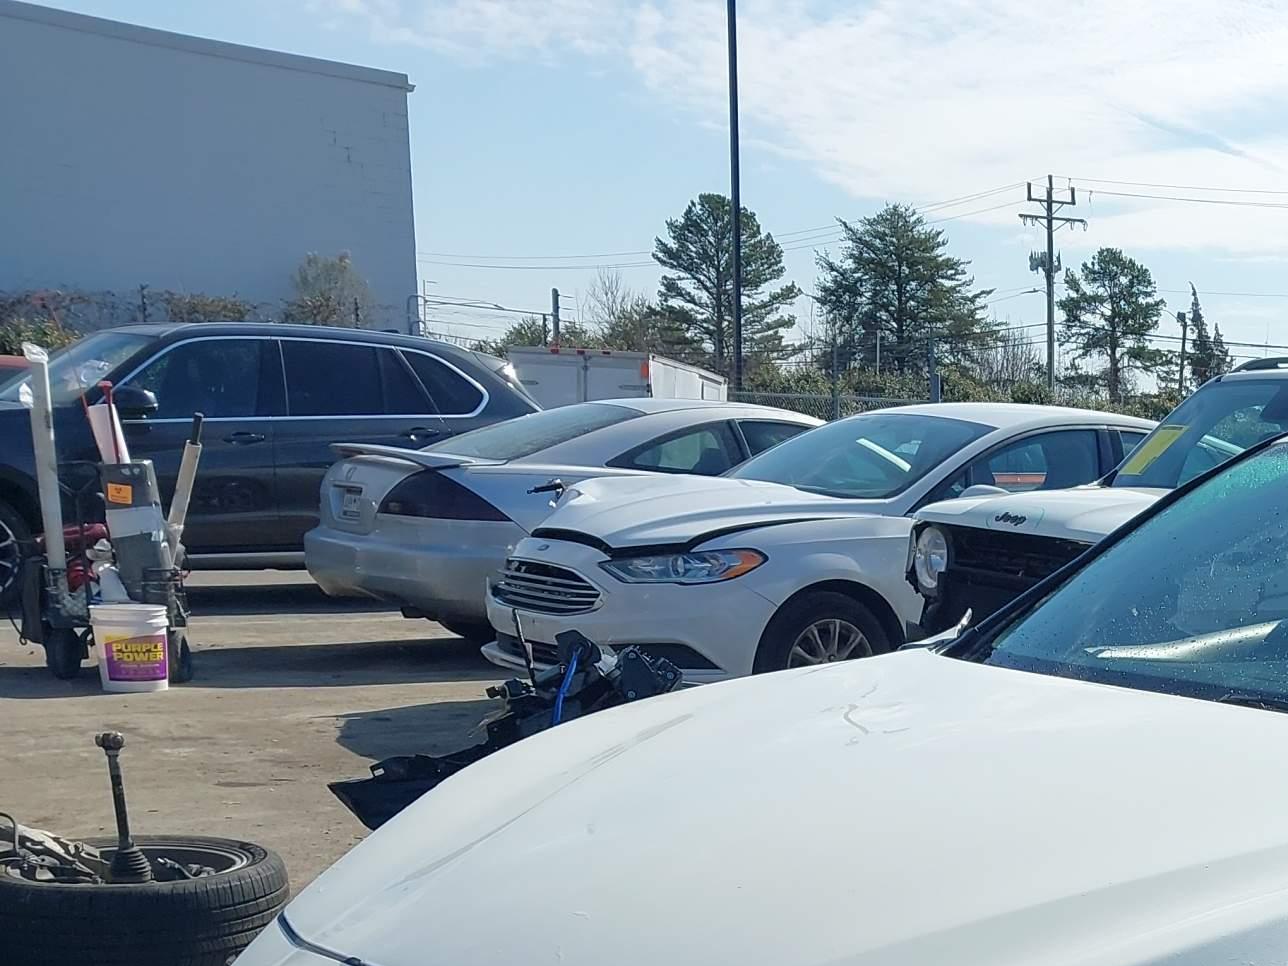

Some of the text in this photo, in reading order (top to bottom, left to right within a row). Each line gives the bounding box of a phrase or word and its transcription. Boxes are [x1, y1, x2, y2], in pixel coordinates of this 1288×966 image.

[995, 511, 1027, 527] Jeep
[112, 642, 164, 652] PURPLE
[112, 652, 164, 661] POWER
